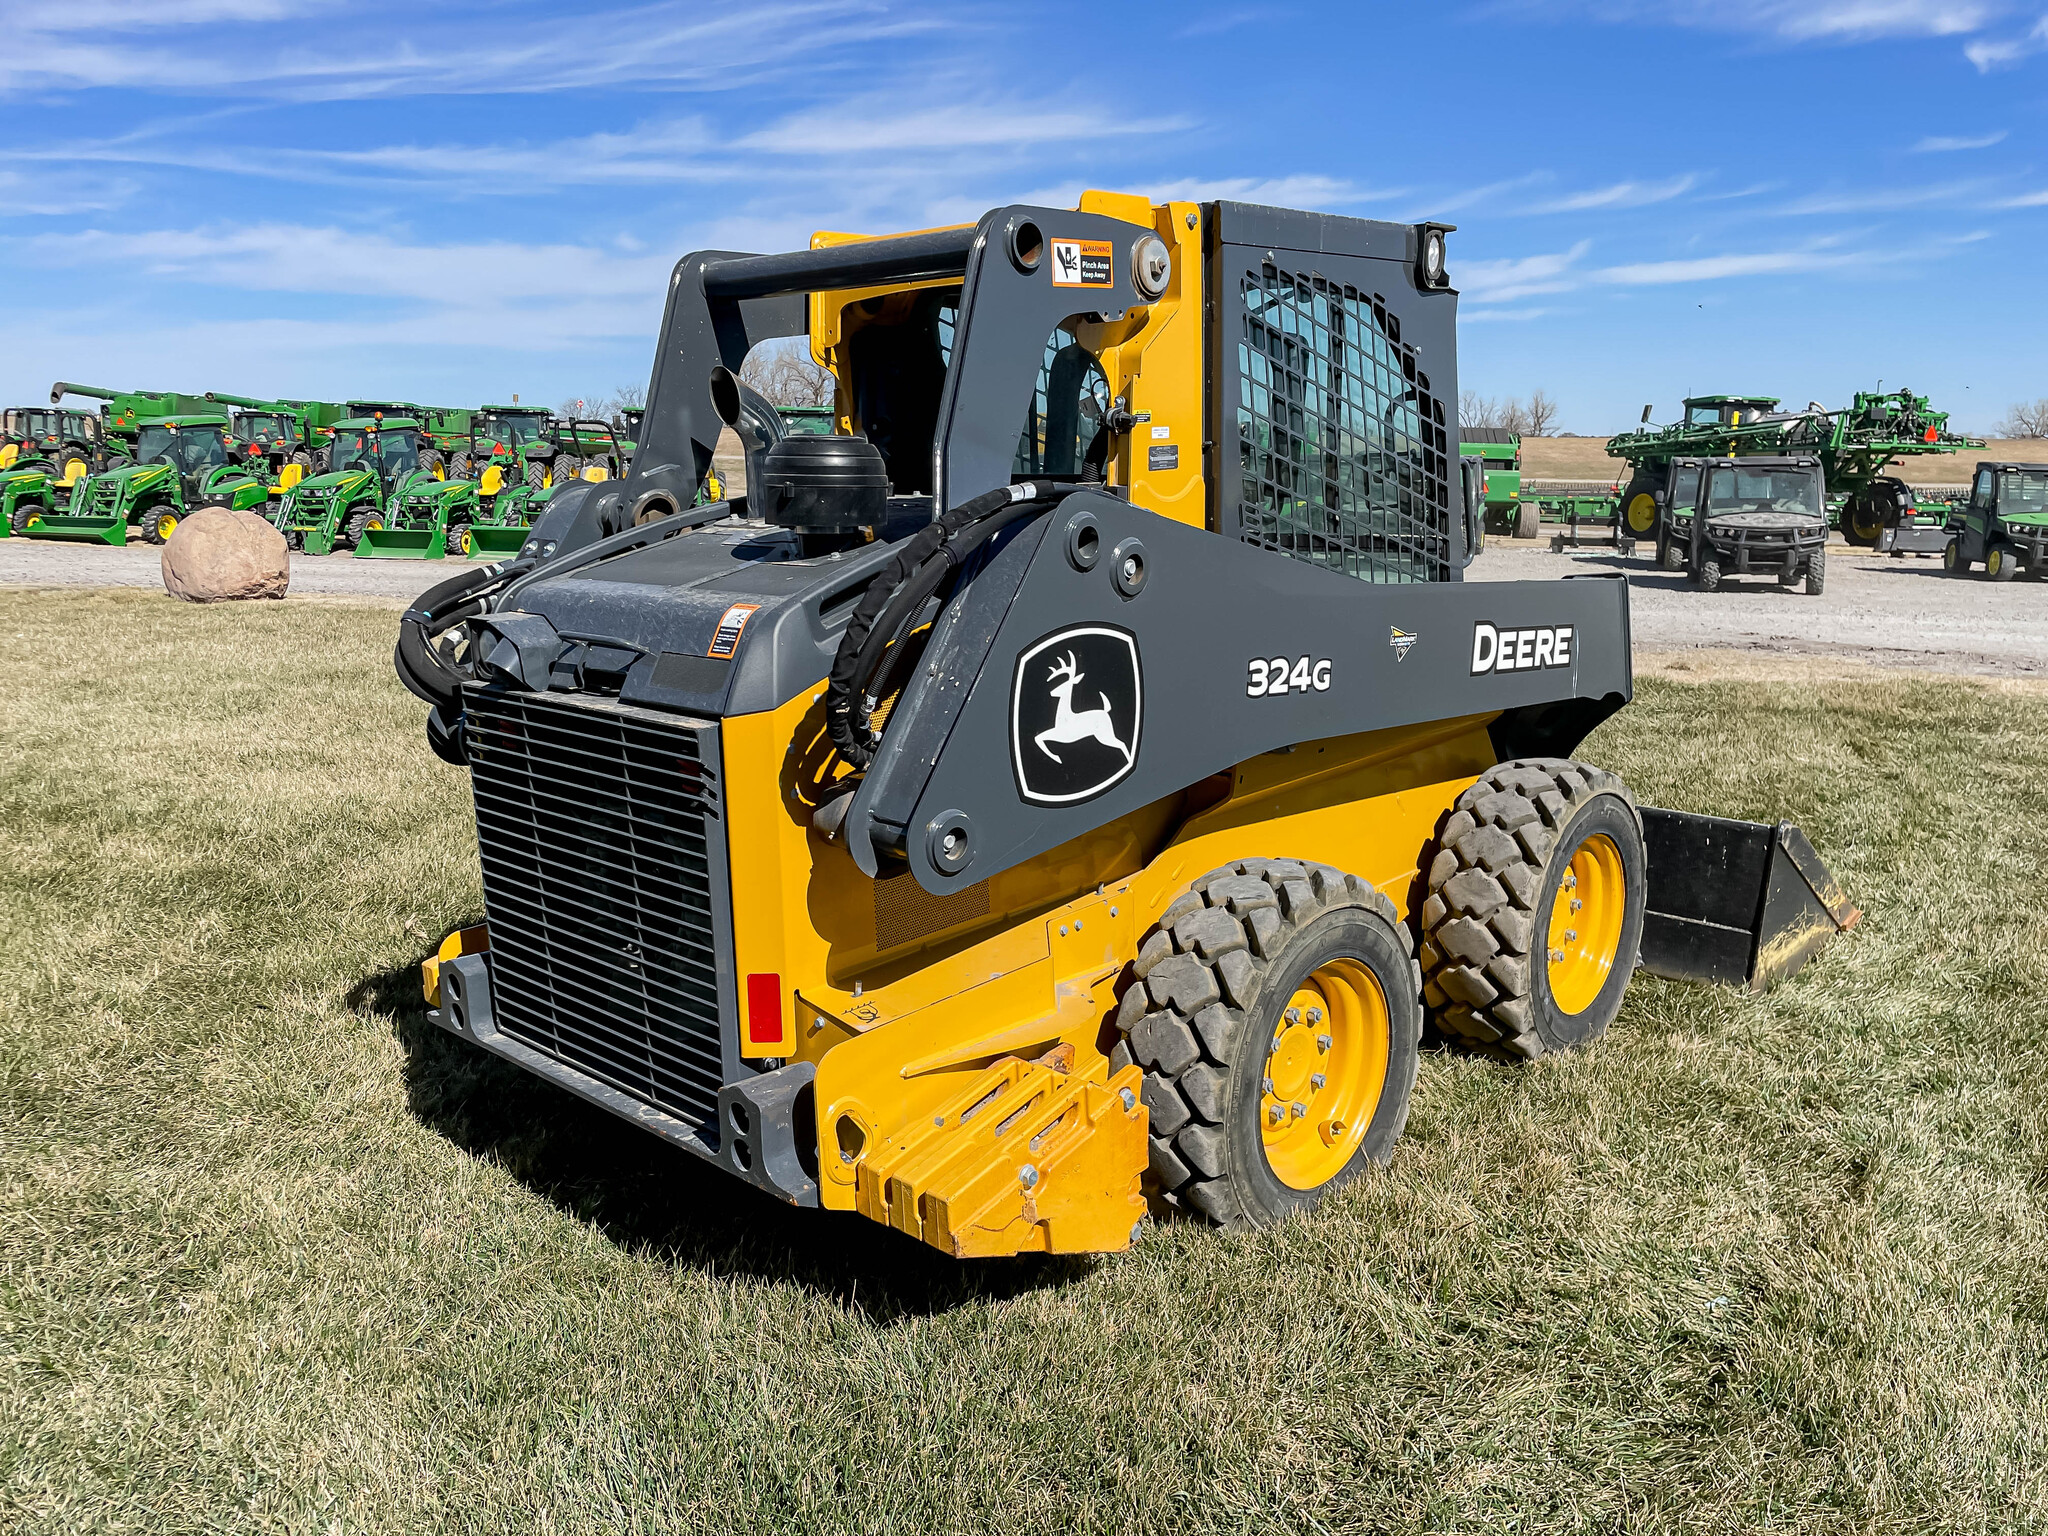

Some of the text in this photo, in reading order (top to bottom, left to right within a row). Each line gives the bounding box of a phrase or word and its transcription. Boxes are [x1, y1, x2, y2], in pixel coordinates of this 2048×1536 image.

[1087, 245, 1110, 253] WARNING
[1082, 261, 1110, 270] Pinch Area
[1082, 271, 1106, 279] Keep Away
[1471, 623, 1573, 673] DEERE
[1247, 656, 1332, 697] 324G
